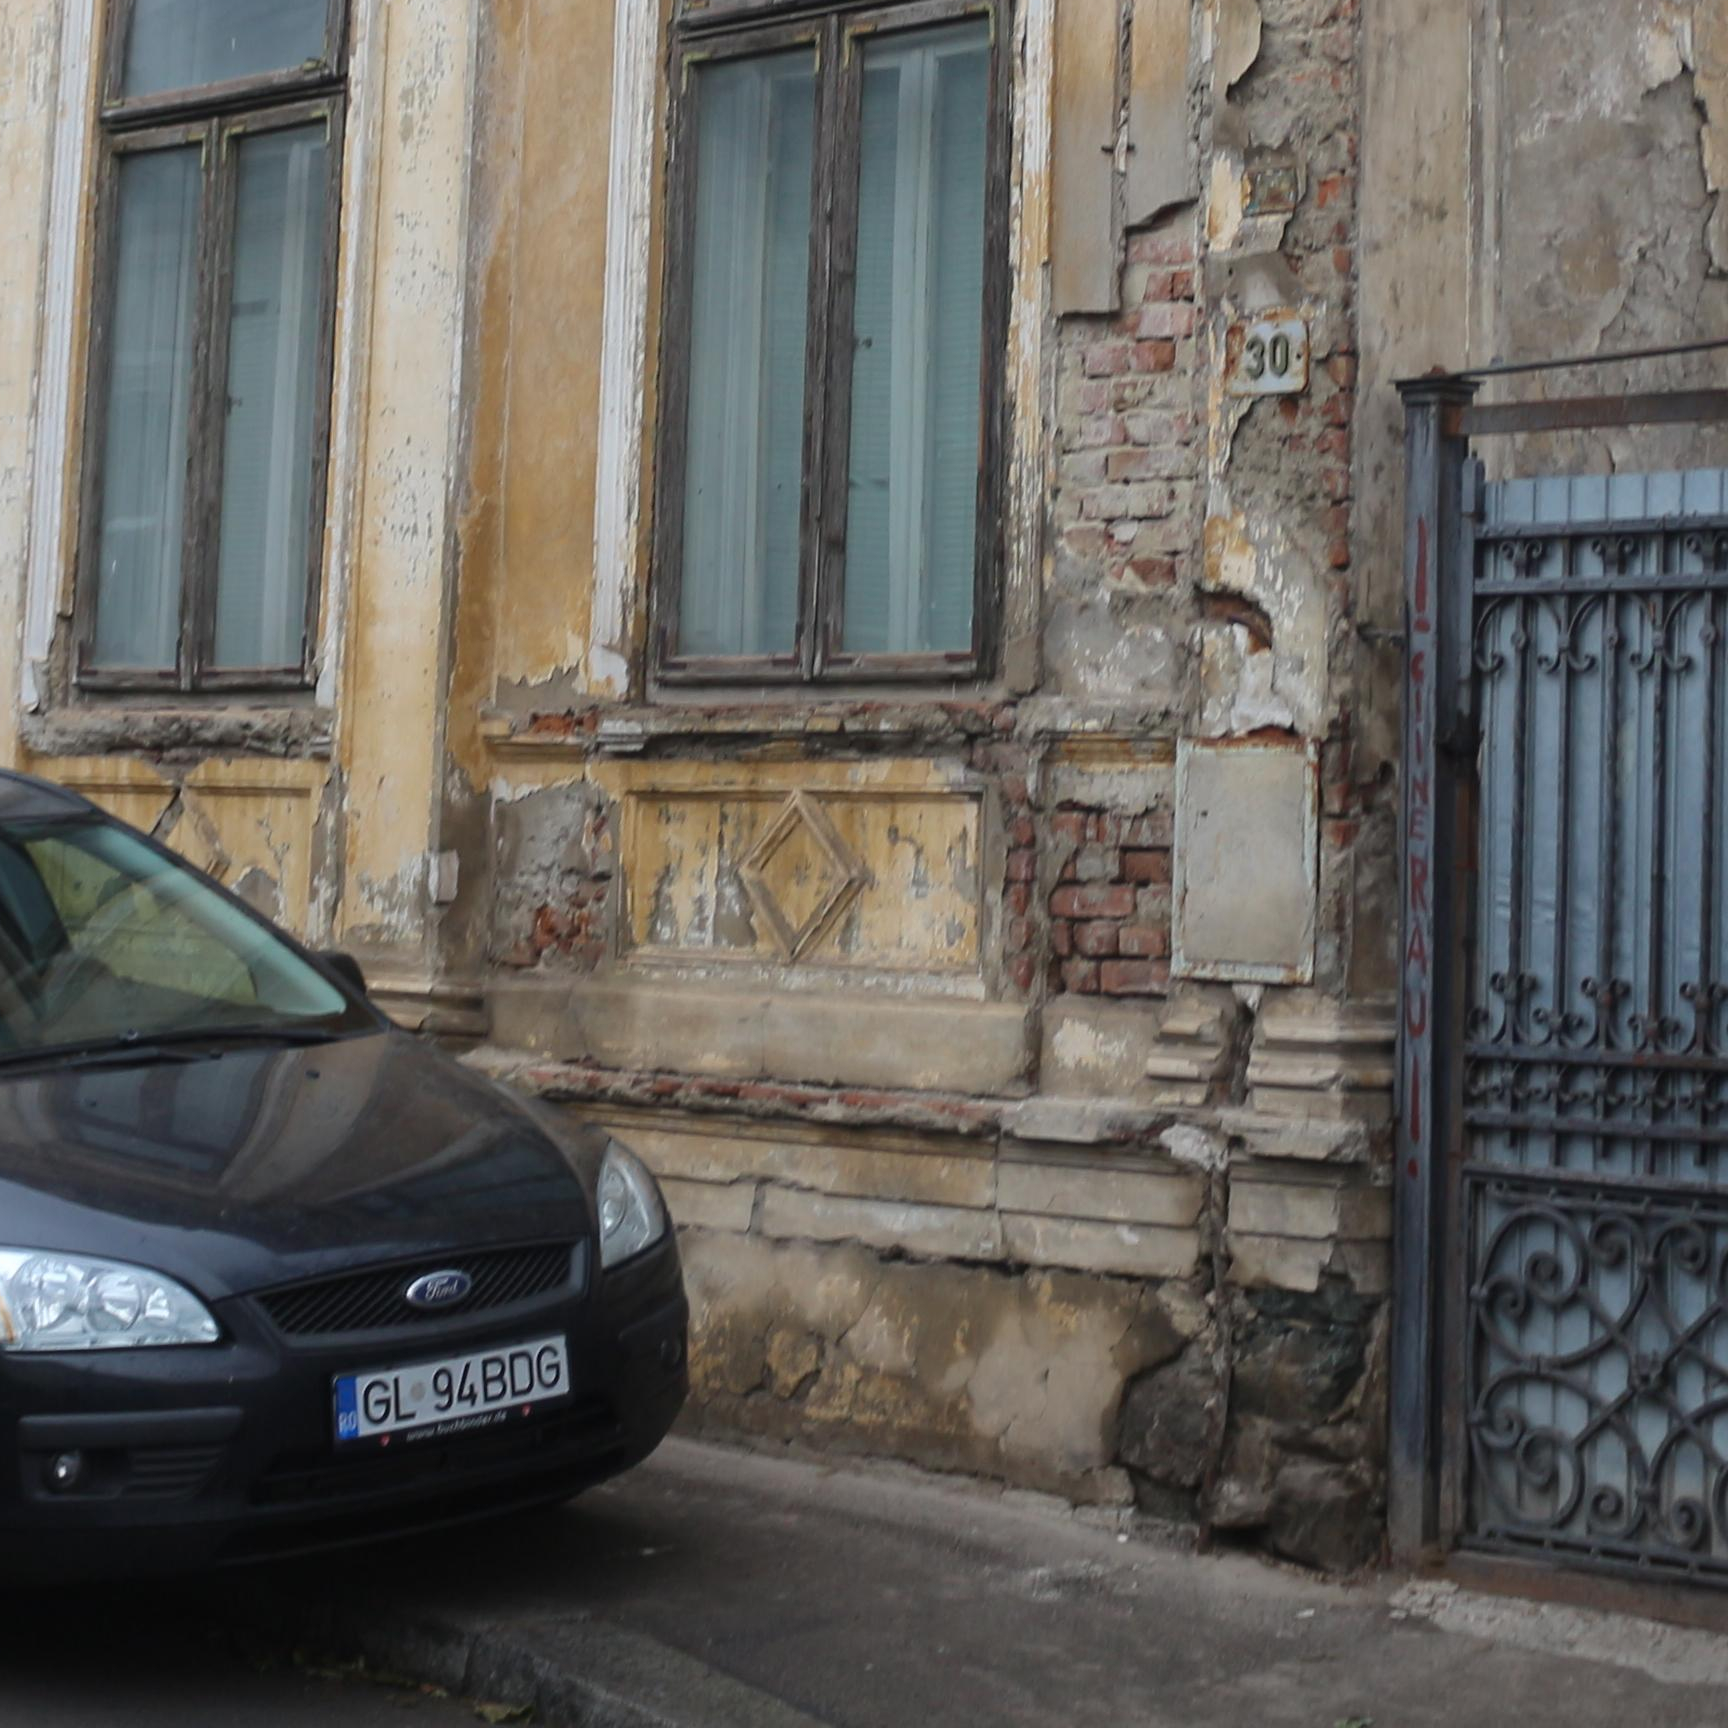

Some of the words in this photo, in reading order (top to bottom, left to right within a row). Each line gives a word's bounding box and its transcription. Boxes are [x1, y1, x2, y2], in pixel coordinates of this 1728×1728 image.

[1245, 333, 1289, 380] 30
[362, 1376, 416, 1424] GL
[431, 1345, 561, 1412] 94BDG
[338, 1412, 357, 1433] RO
